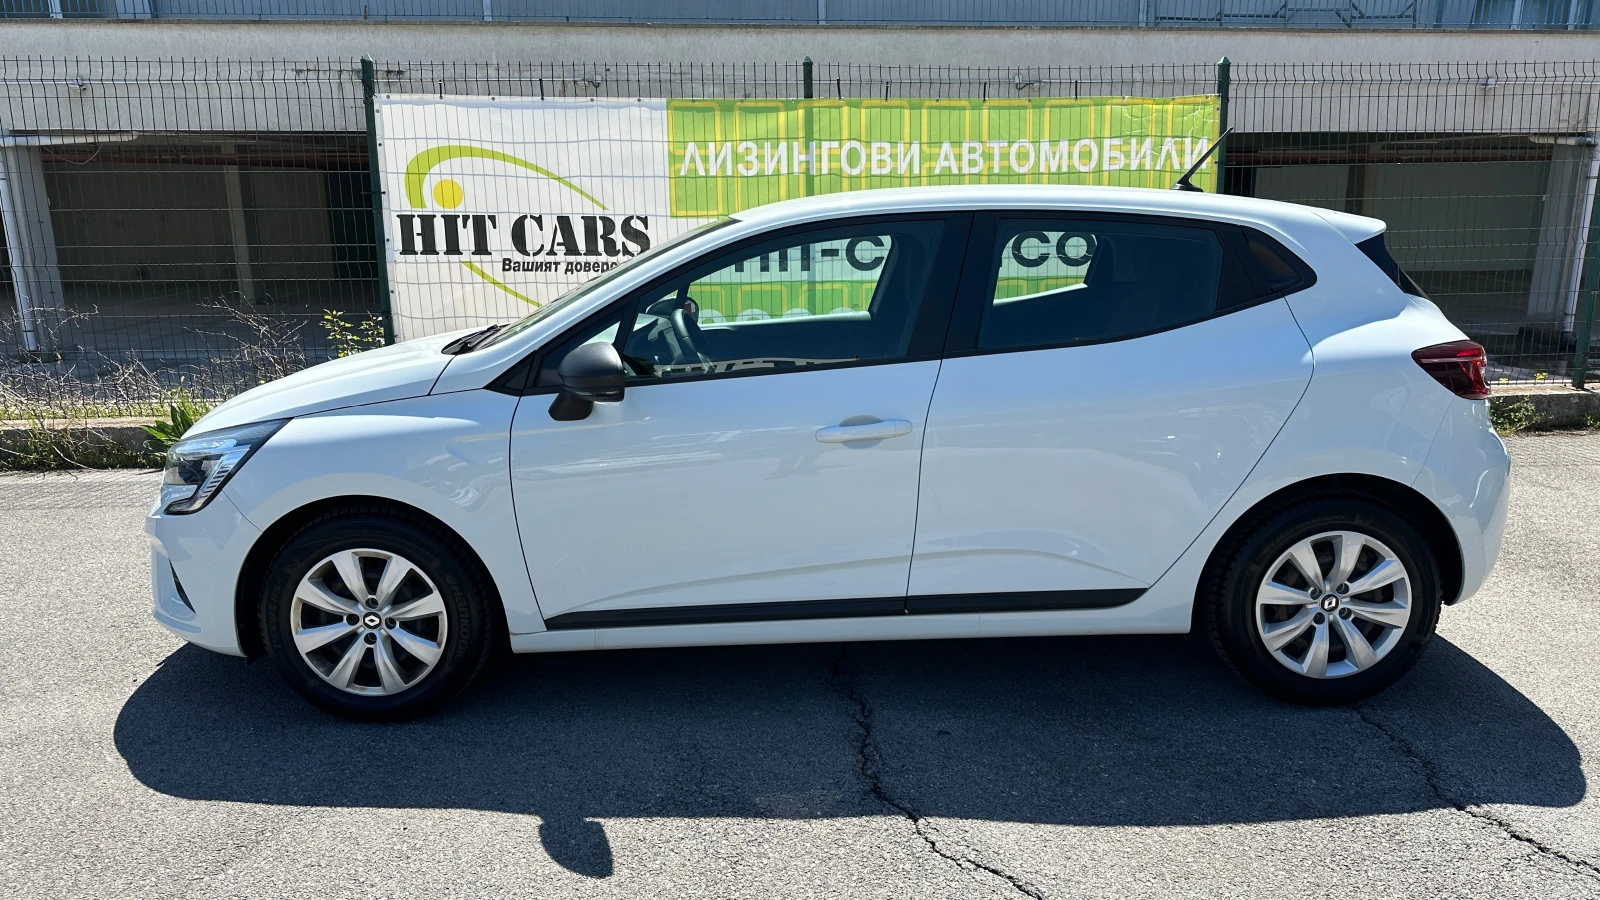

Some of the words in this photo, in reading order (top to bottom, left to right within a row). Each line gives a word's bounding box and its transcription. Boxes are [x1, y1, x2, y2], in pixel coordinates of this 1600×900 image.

[680, 140, 921, 177] ЛИЗИНГОВИ
[934, 136, 1208, 175] АВТОМОБИЛИ
[397, 214, 497, 256] HIT
[511, 214, 651, 257] CARS
[501, 258, 560, 273] Вашият
